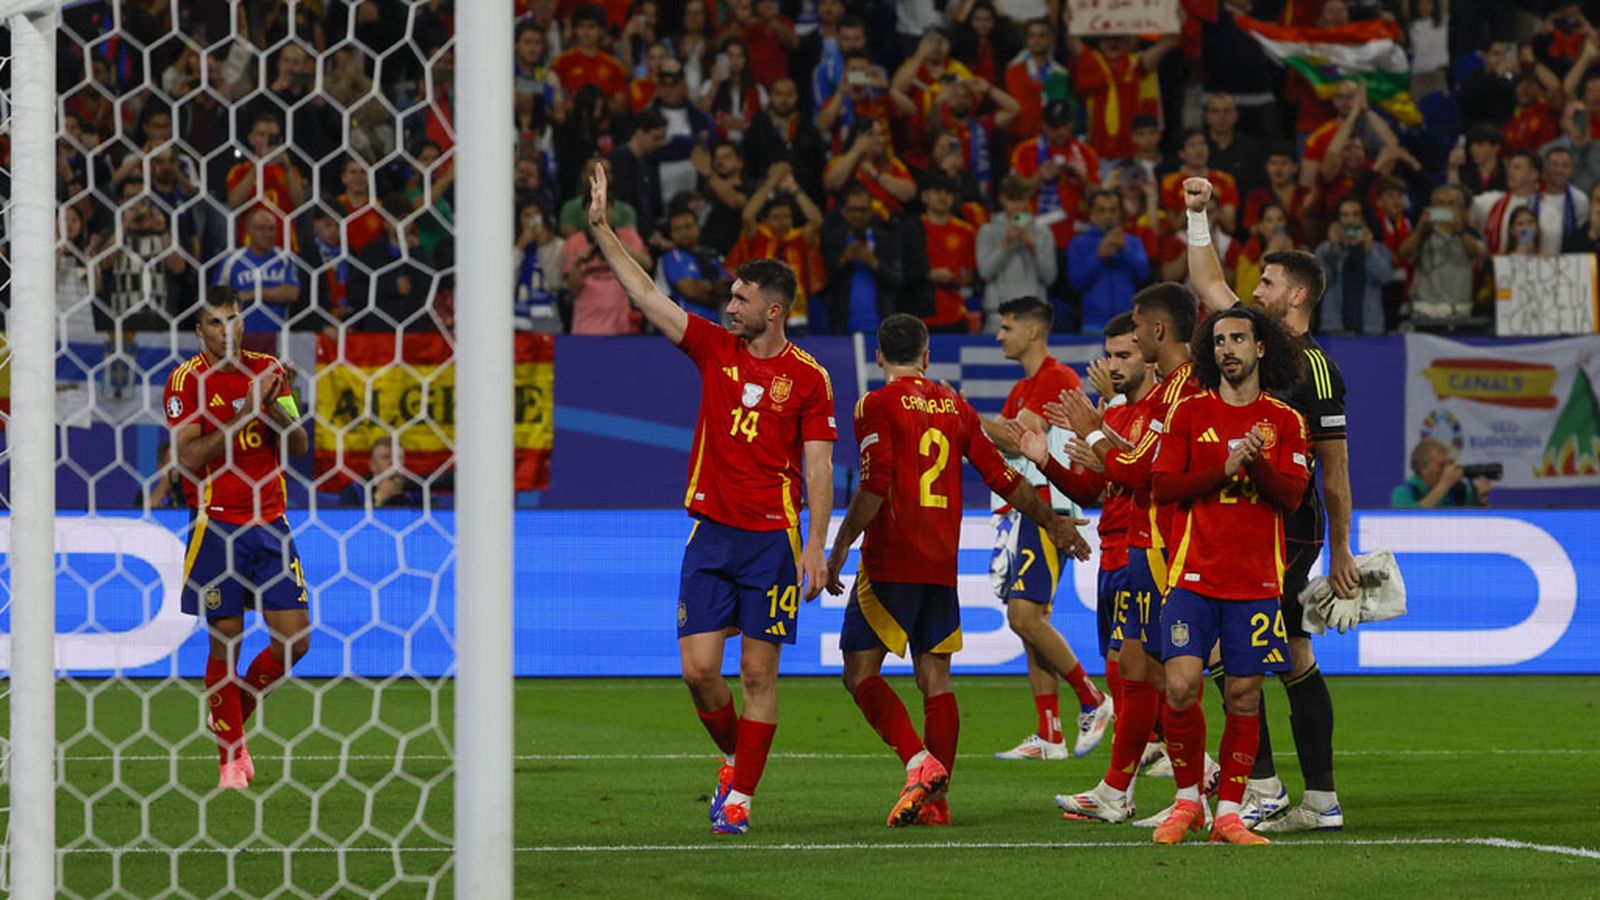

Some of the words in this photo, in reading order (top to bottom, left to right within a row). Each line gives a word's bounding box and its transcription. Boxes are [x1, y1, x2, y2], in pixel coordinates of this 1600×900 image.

[239, 419, 262, 450] 16
[730, 405, 760, 443] 14
[919, 427, 949, 509] 2
[1017, 548, 1036, 576] 7
[766, 584, 798, 619] 14
[1113, 590, 1131, 624] 15
[1135, 591, 1151, 624] 11
[1250, 609, 1288, 647] 24
